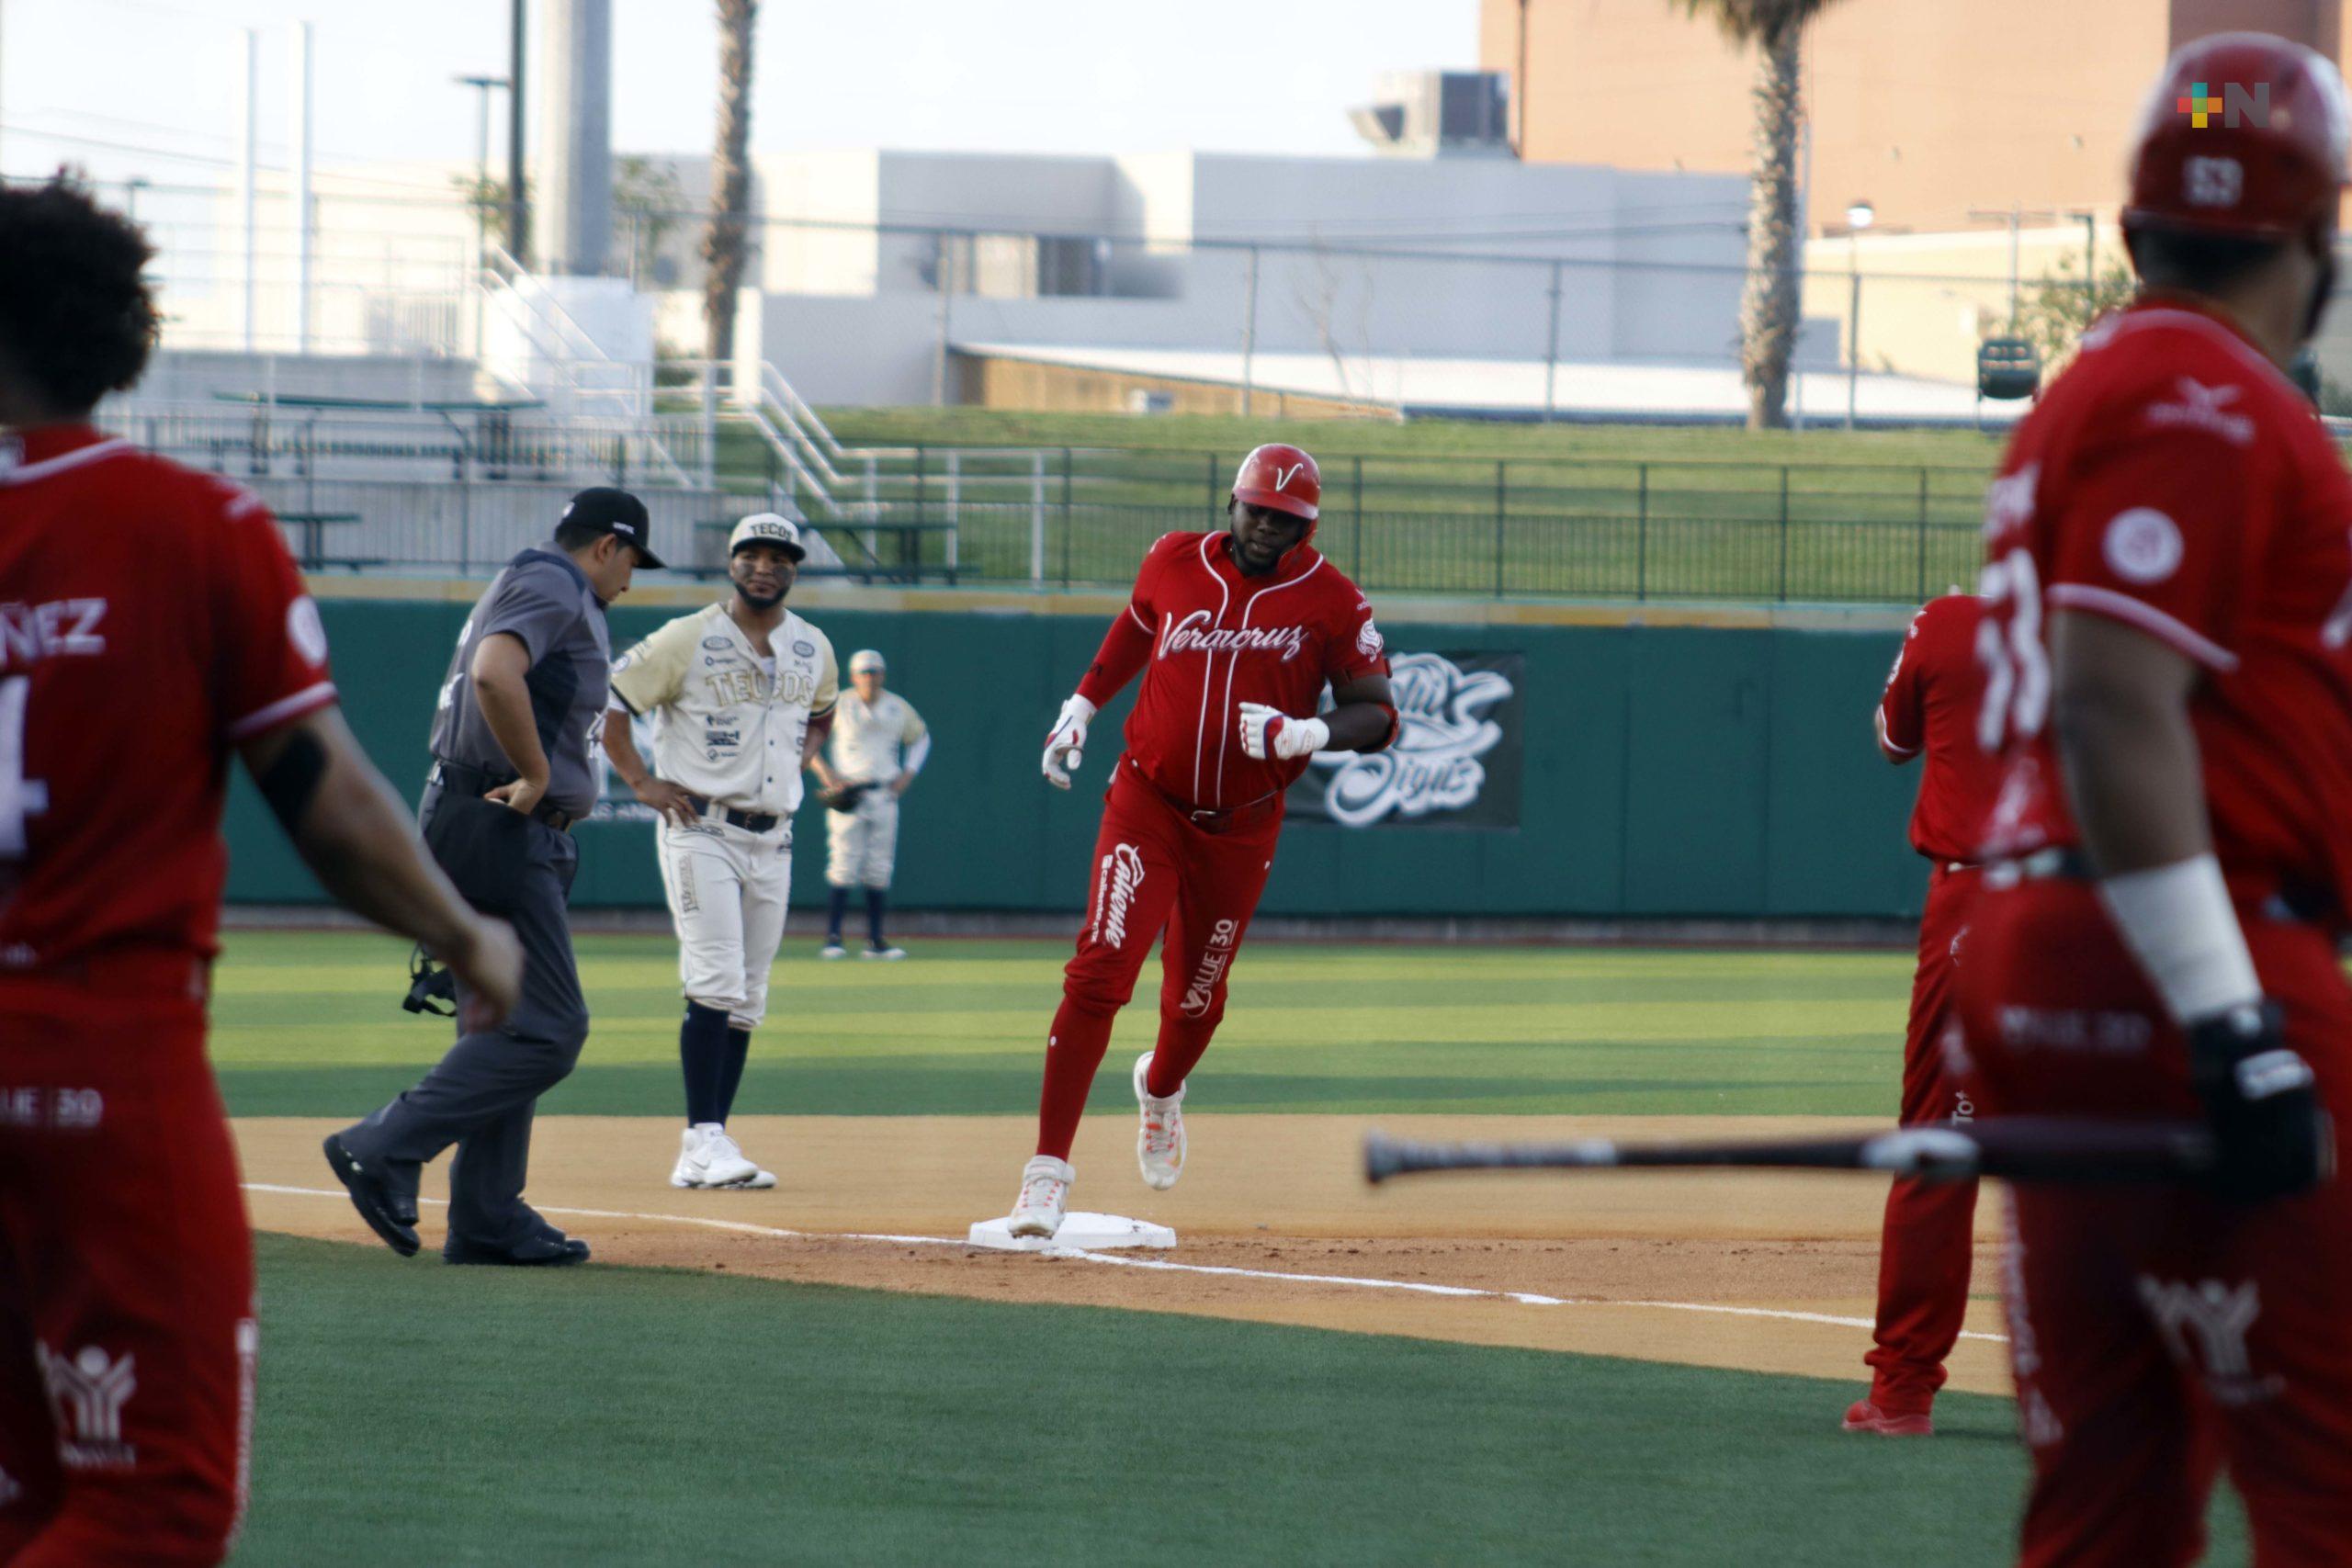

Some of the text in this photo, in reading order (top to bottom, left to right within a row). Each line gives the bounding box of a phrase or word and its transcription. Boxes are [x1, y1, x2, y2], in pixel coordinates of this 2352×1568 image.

[1275, 462, 1304, 491] V
[1157, 609, 1309, 662] Veracruz
[1105, 842, 1145, 950] Caliente
[1180, 919, 1233, 1018] VALUE 30
